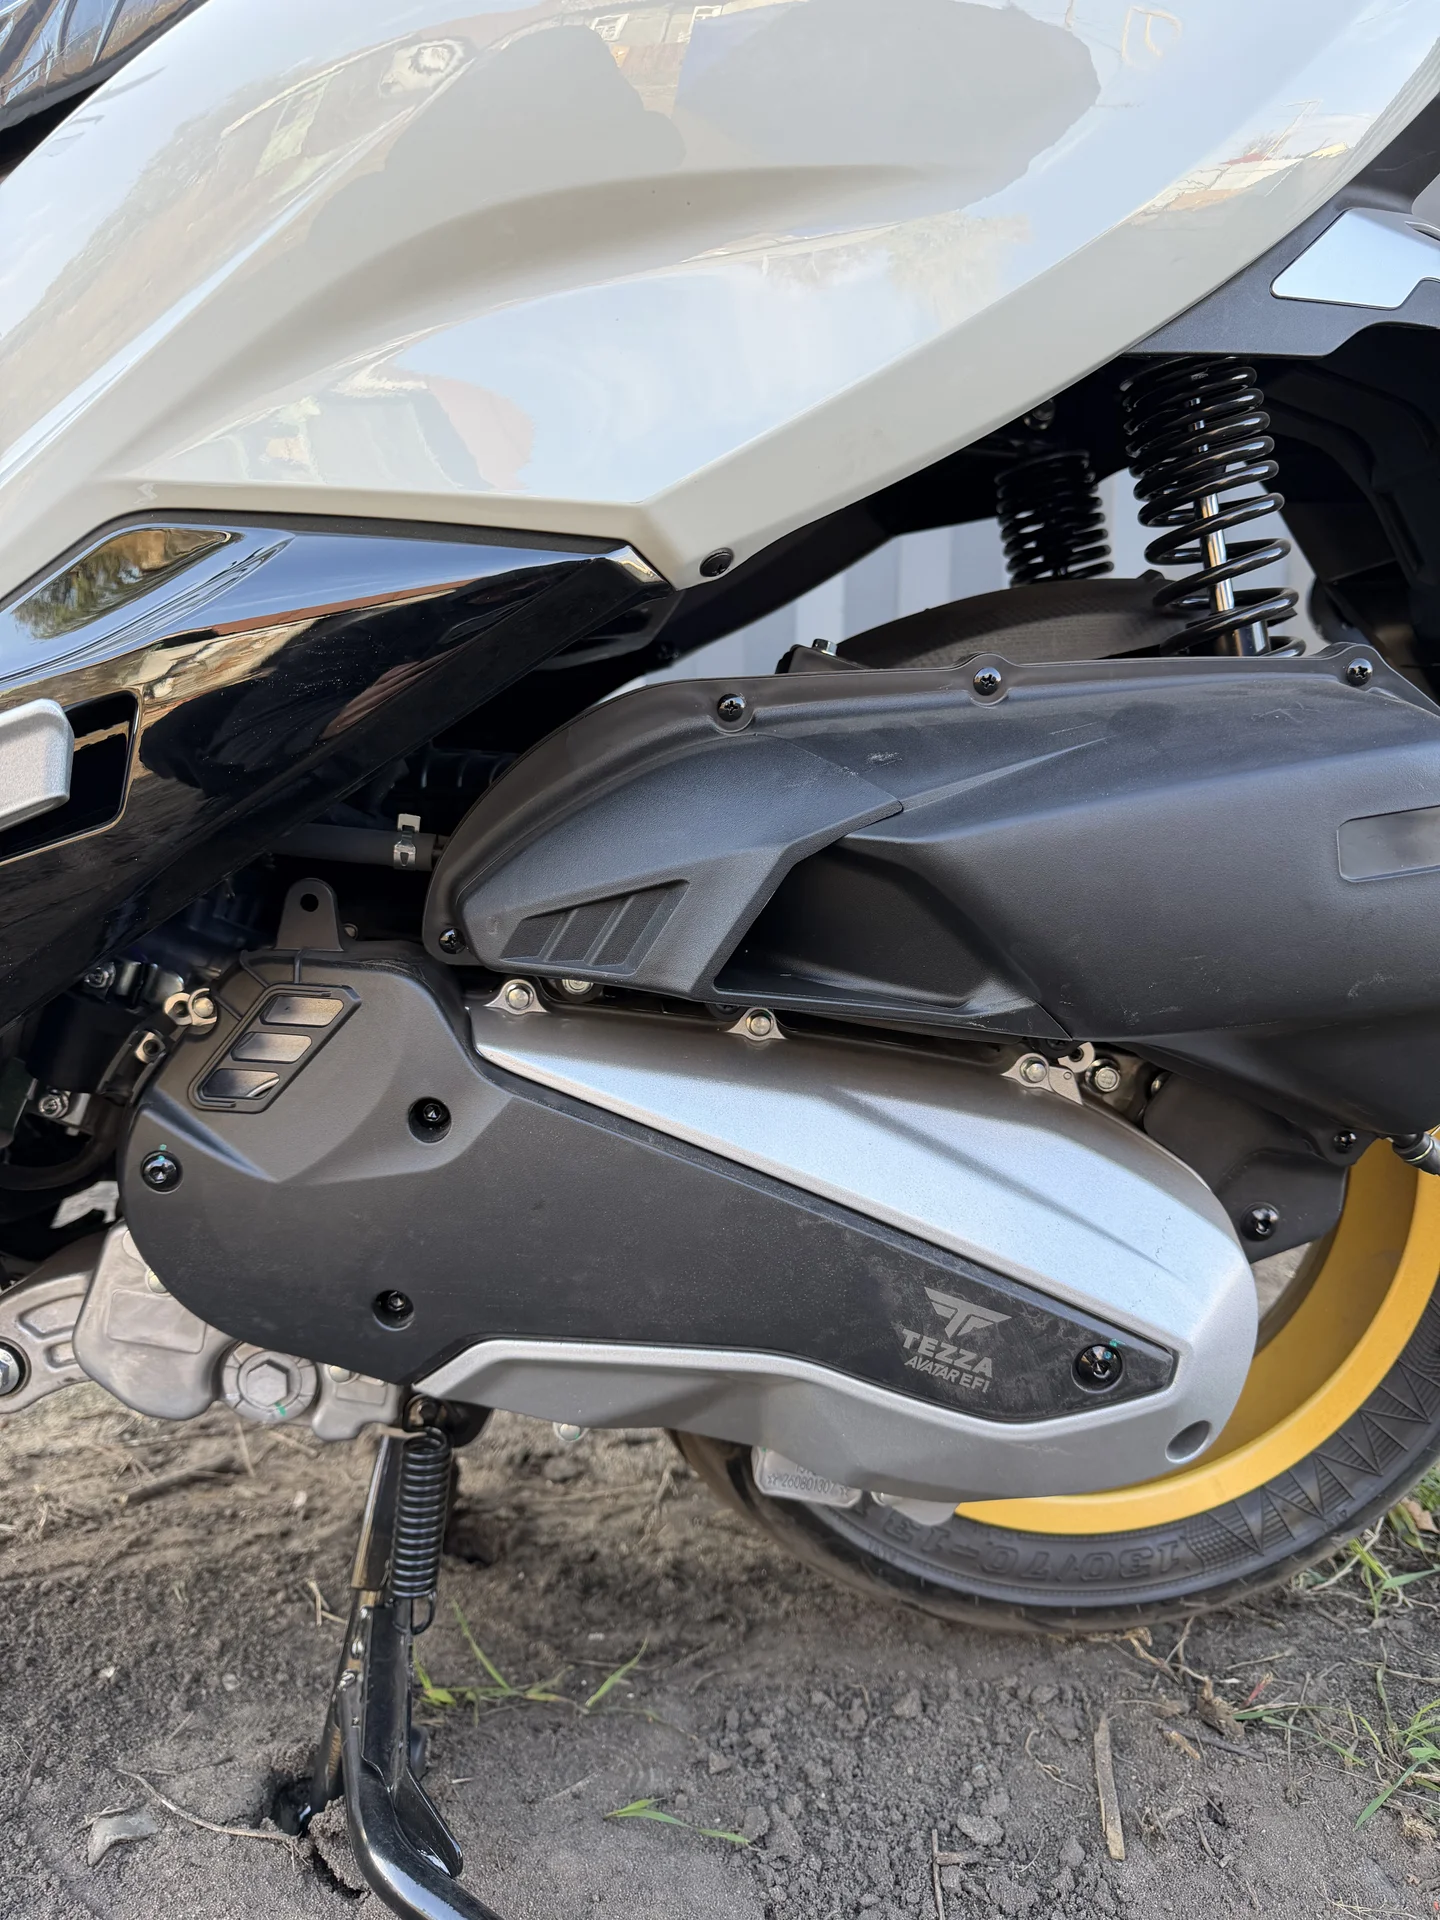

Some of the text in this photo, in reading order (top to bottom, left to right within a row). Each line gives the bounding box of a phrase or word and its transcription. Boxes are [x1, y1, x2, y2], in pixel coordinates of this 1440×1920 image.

[902, 1328, 993, 1379] TEZZA
[904, 1355, 991, 1393] AVATAR EFI
